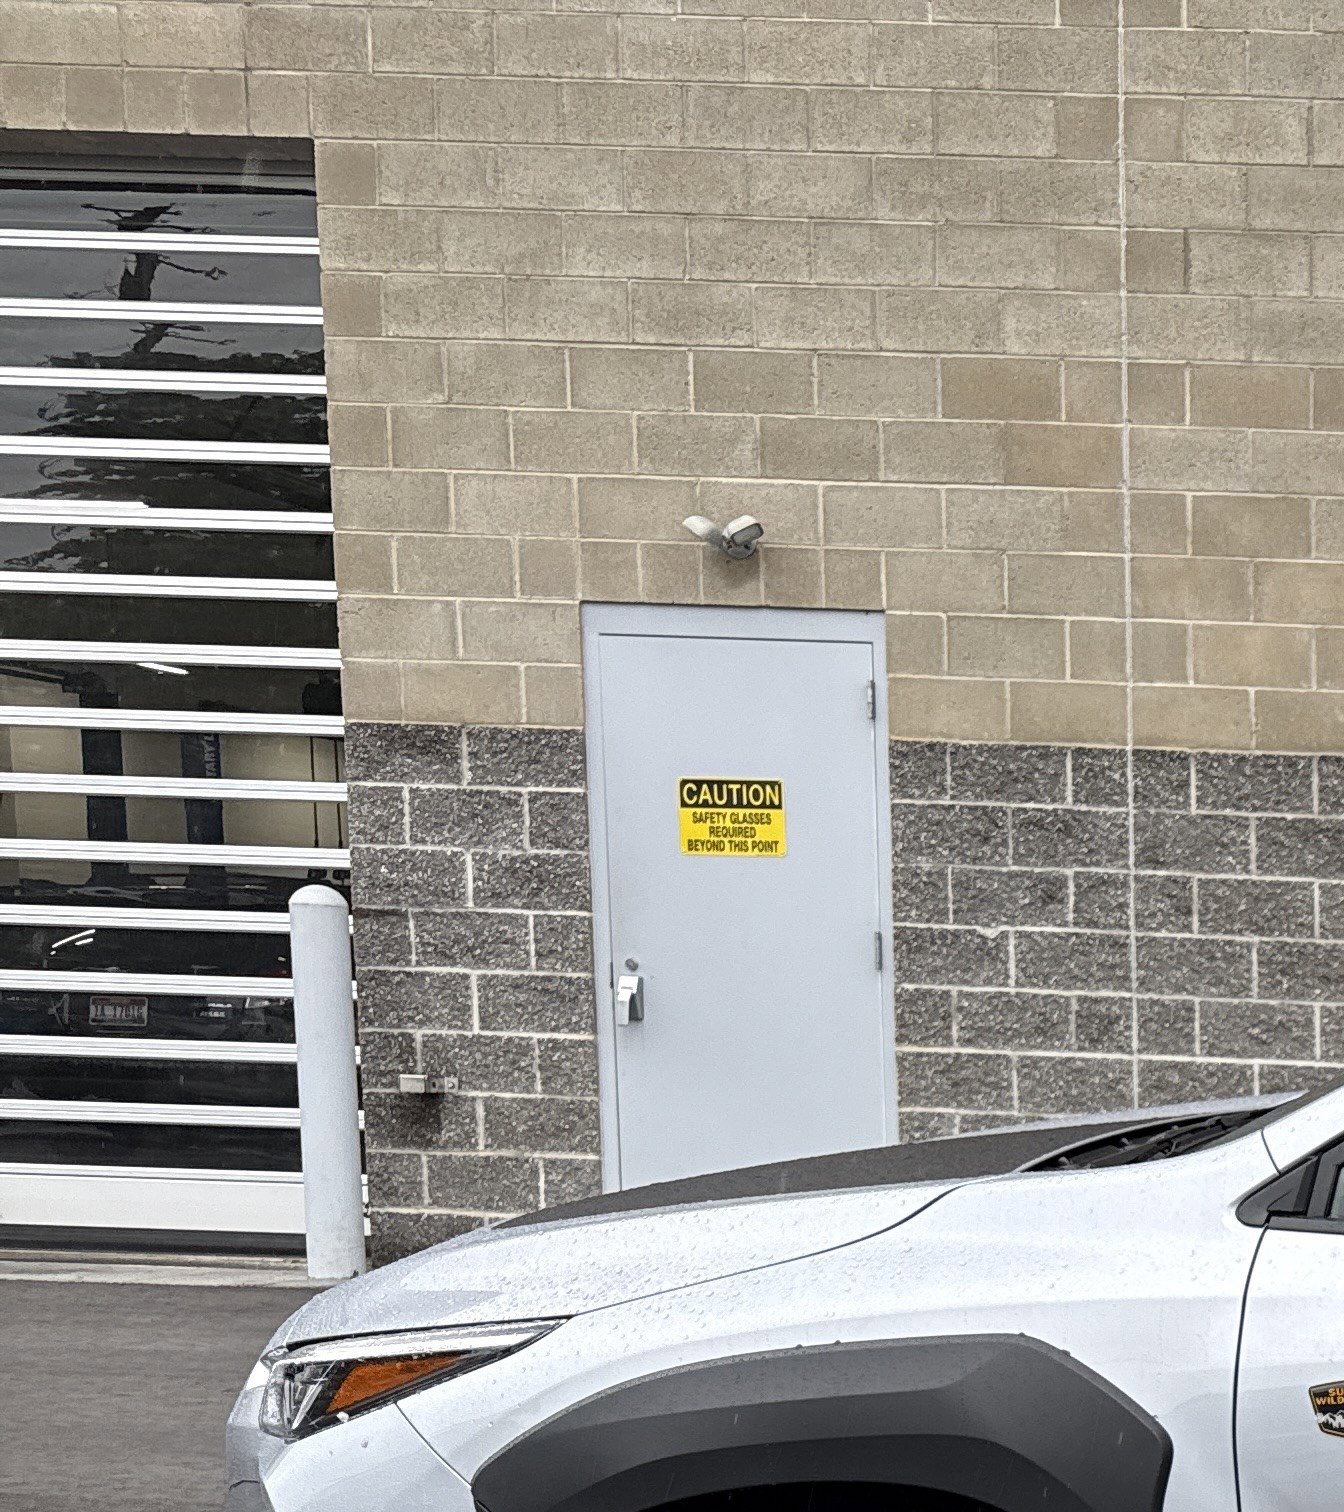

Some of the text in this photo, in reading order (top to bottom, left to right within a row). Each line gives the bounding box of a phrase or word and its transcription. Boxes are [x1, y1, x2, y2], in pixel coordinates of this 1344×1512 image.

[682, 782, 780, 806] CAUTION
[692, 811, 772, 825] SAFETY GLASSES
[709, 826, 756, 838] REQUIRED
[687, 839, 779, 853] BEYOND THIS POINT
